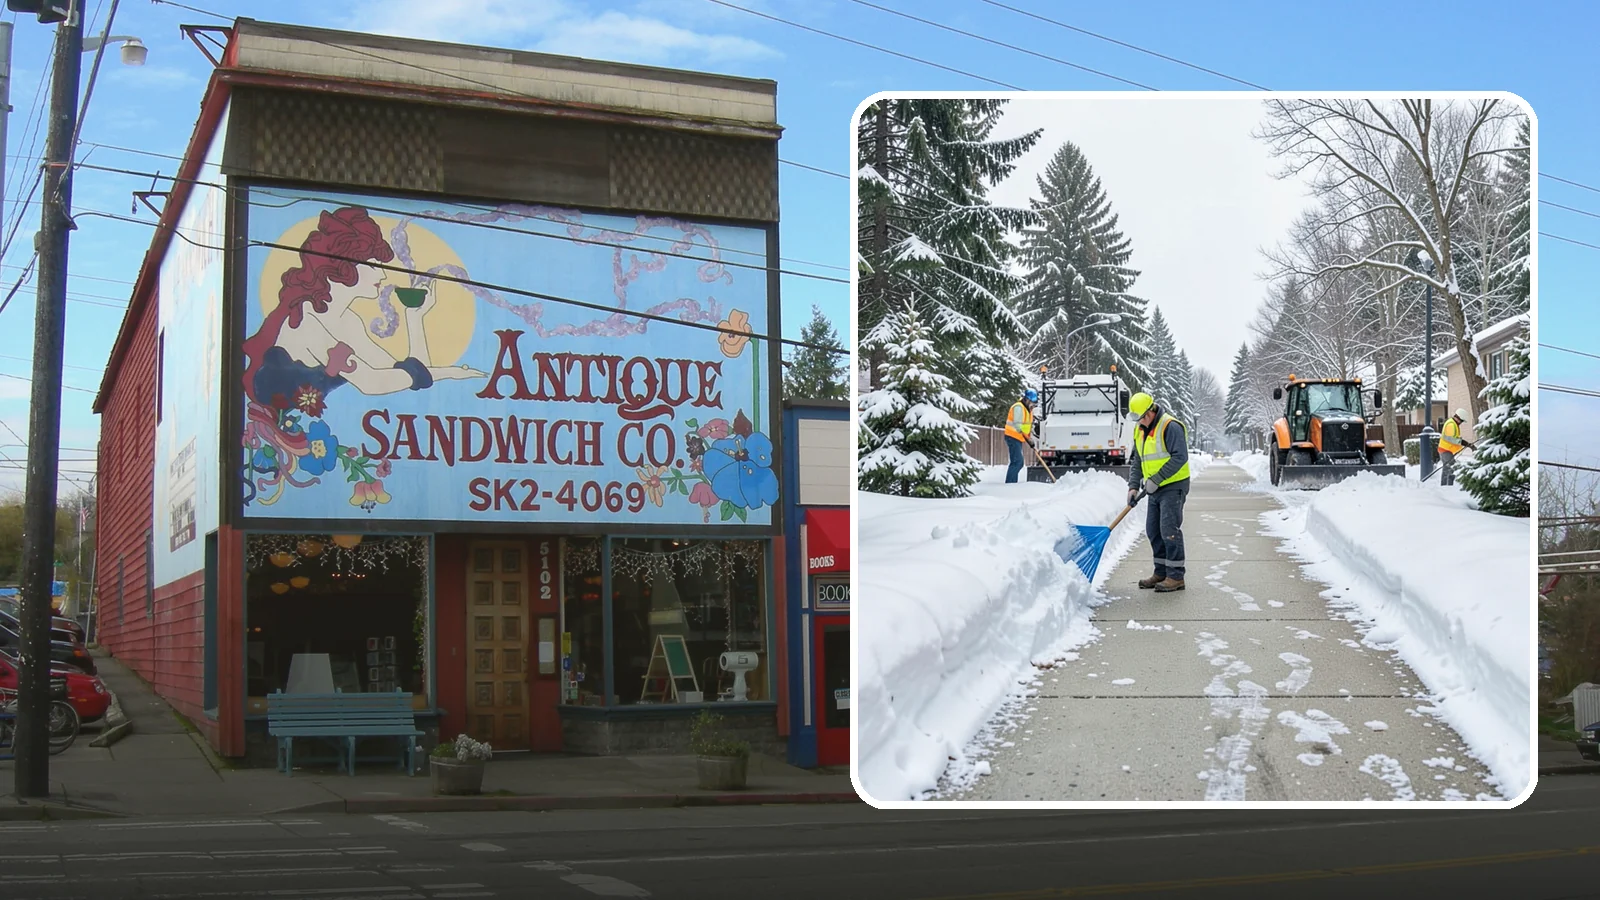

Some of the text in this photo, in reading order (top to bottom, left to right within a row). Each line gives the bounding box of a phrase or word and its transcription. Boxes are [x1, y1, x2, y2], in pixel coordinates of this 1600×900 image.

[475, 329, 723, 421] ANTIQUE
[361, 409, 685, 469] SANDWICH CO.
[468, 477, 645, 512] SK2-4069
[540, 542, 551, 600] 5102
[809, 555, 835, 569] BOOKS
